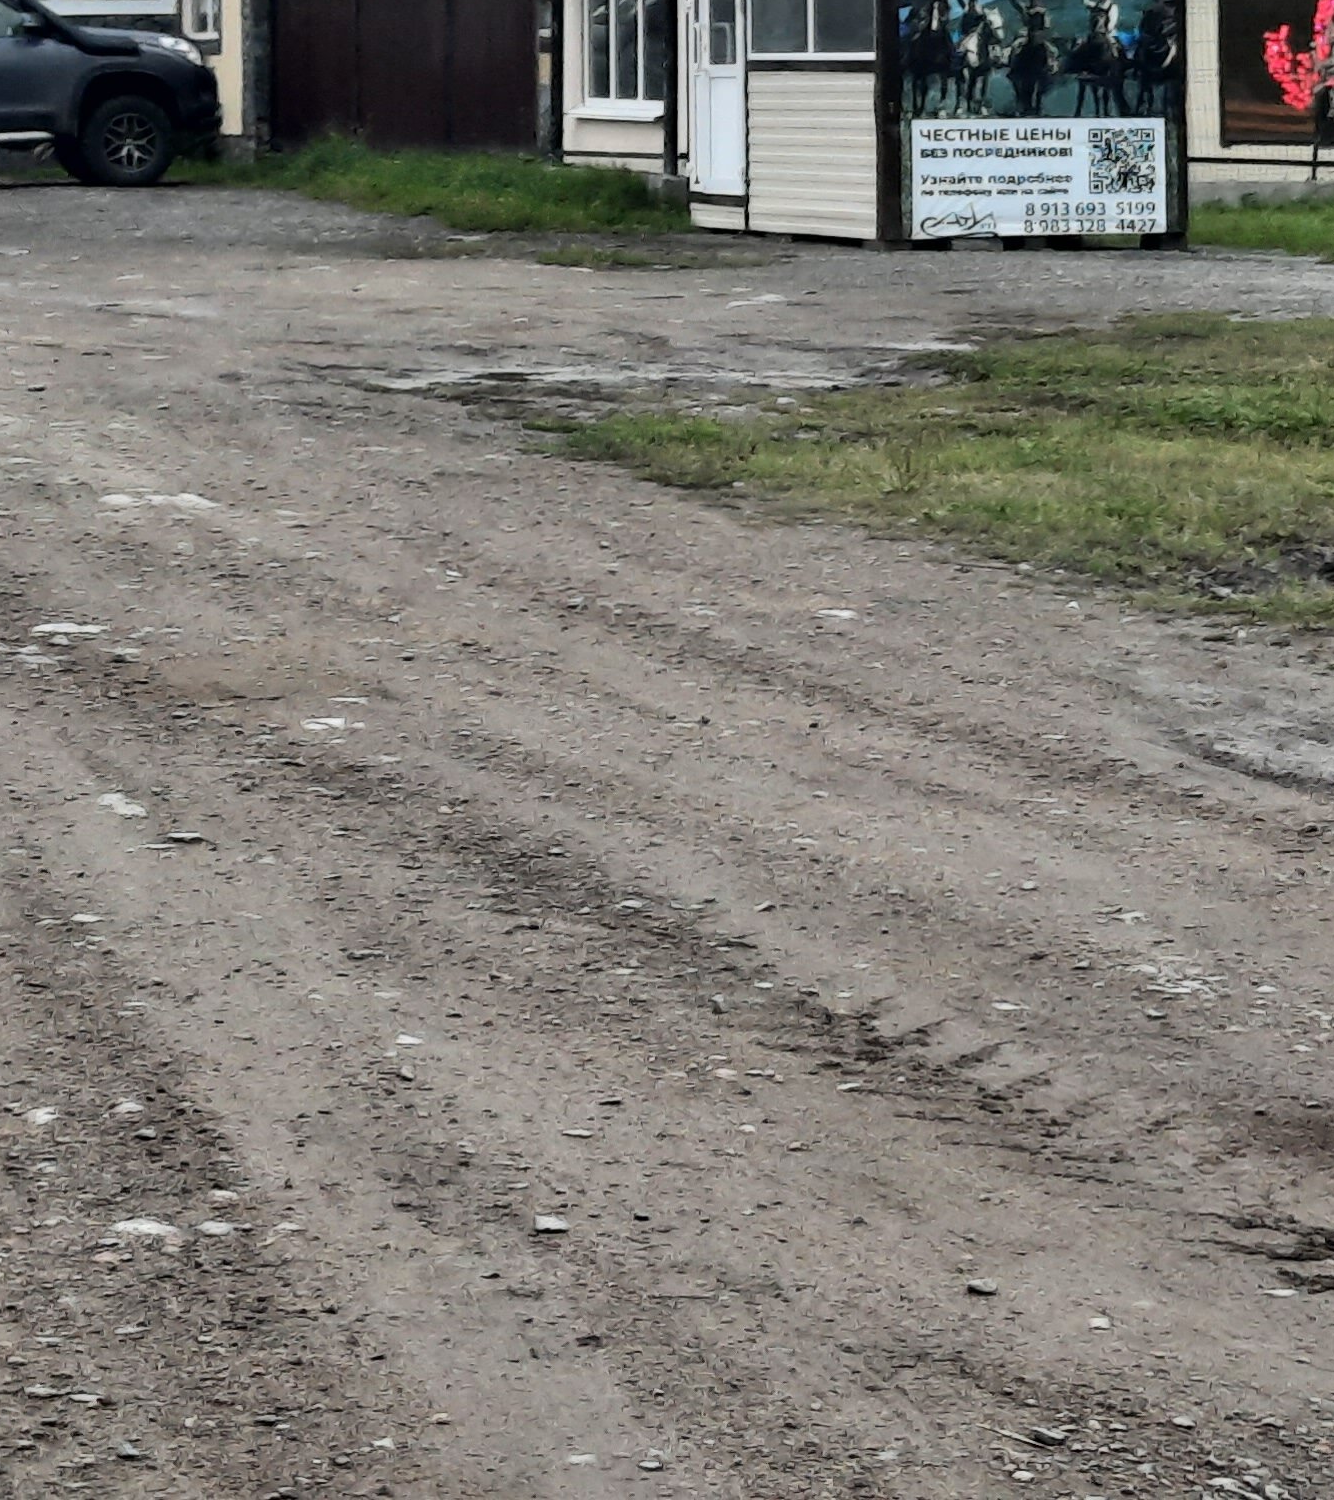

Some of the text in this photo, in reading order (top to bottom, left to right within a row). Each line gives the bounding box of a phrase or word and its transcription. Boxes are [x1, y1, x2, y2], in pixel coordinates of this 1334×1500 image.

[919, 127, 1072, 142] ЧЕСТНЫЕ ЦЕНЫ
[921, 172, 983, 185] Узнайте
[1025, 201, 1156, 216] 8 913 693 5199
[1024, 219, 1034, 233] 8
[1115, 218, 1157, 233] 4427
